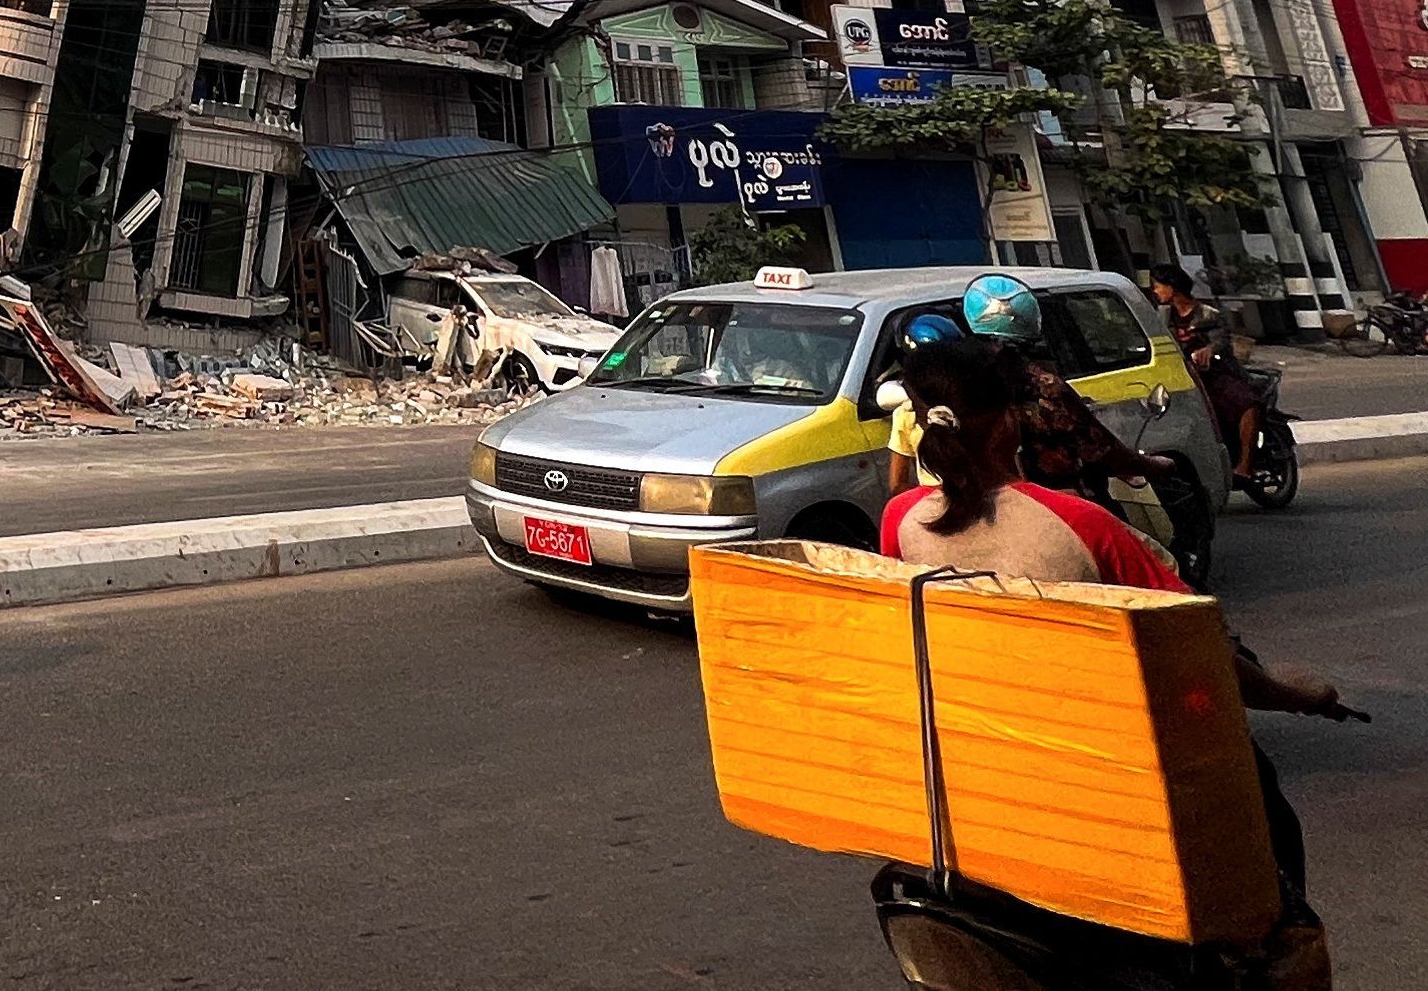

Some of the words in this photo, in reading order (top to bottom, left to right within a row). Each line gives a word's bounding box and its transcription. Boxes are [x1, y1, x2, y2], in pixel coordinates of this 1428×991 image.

[846, 25, 870, 39] UPG
[762, 272, 792, 285] TAXI
[527, 525, 585, 555] 7G-5671
